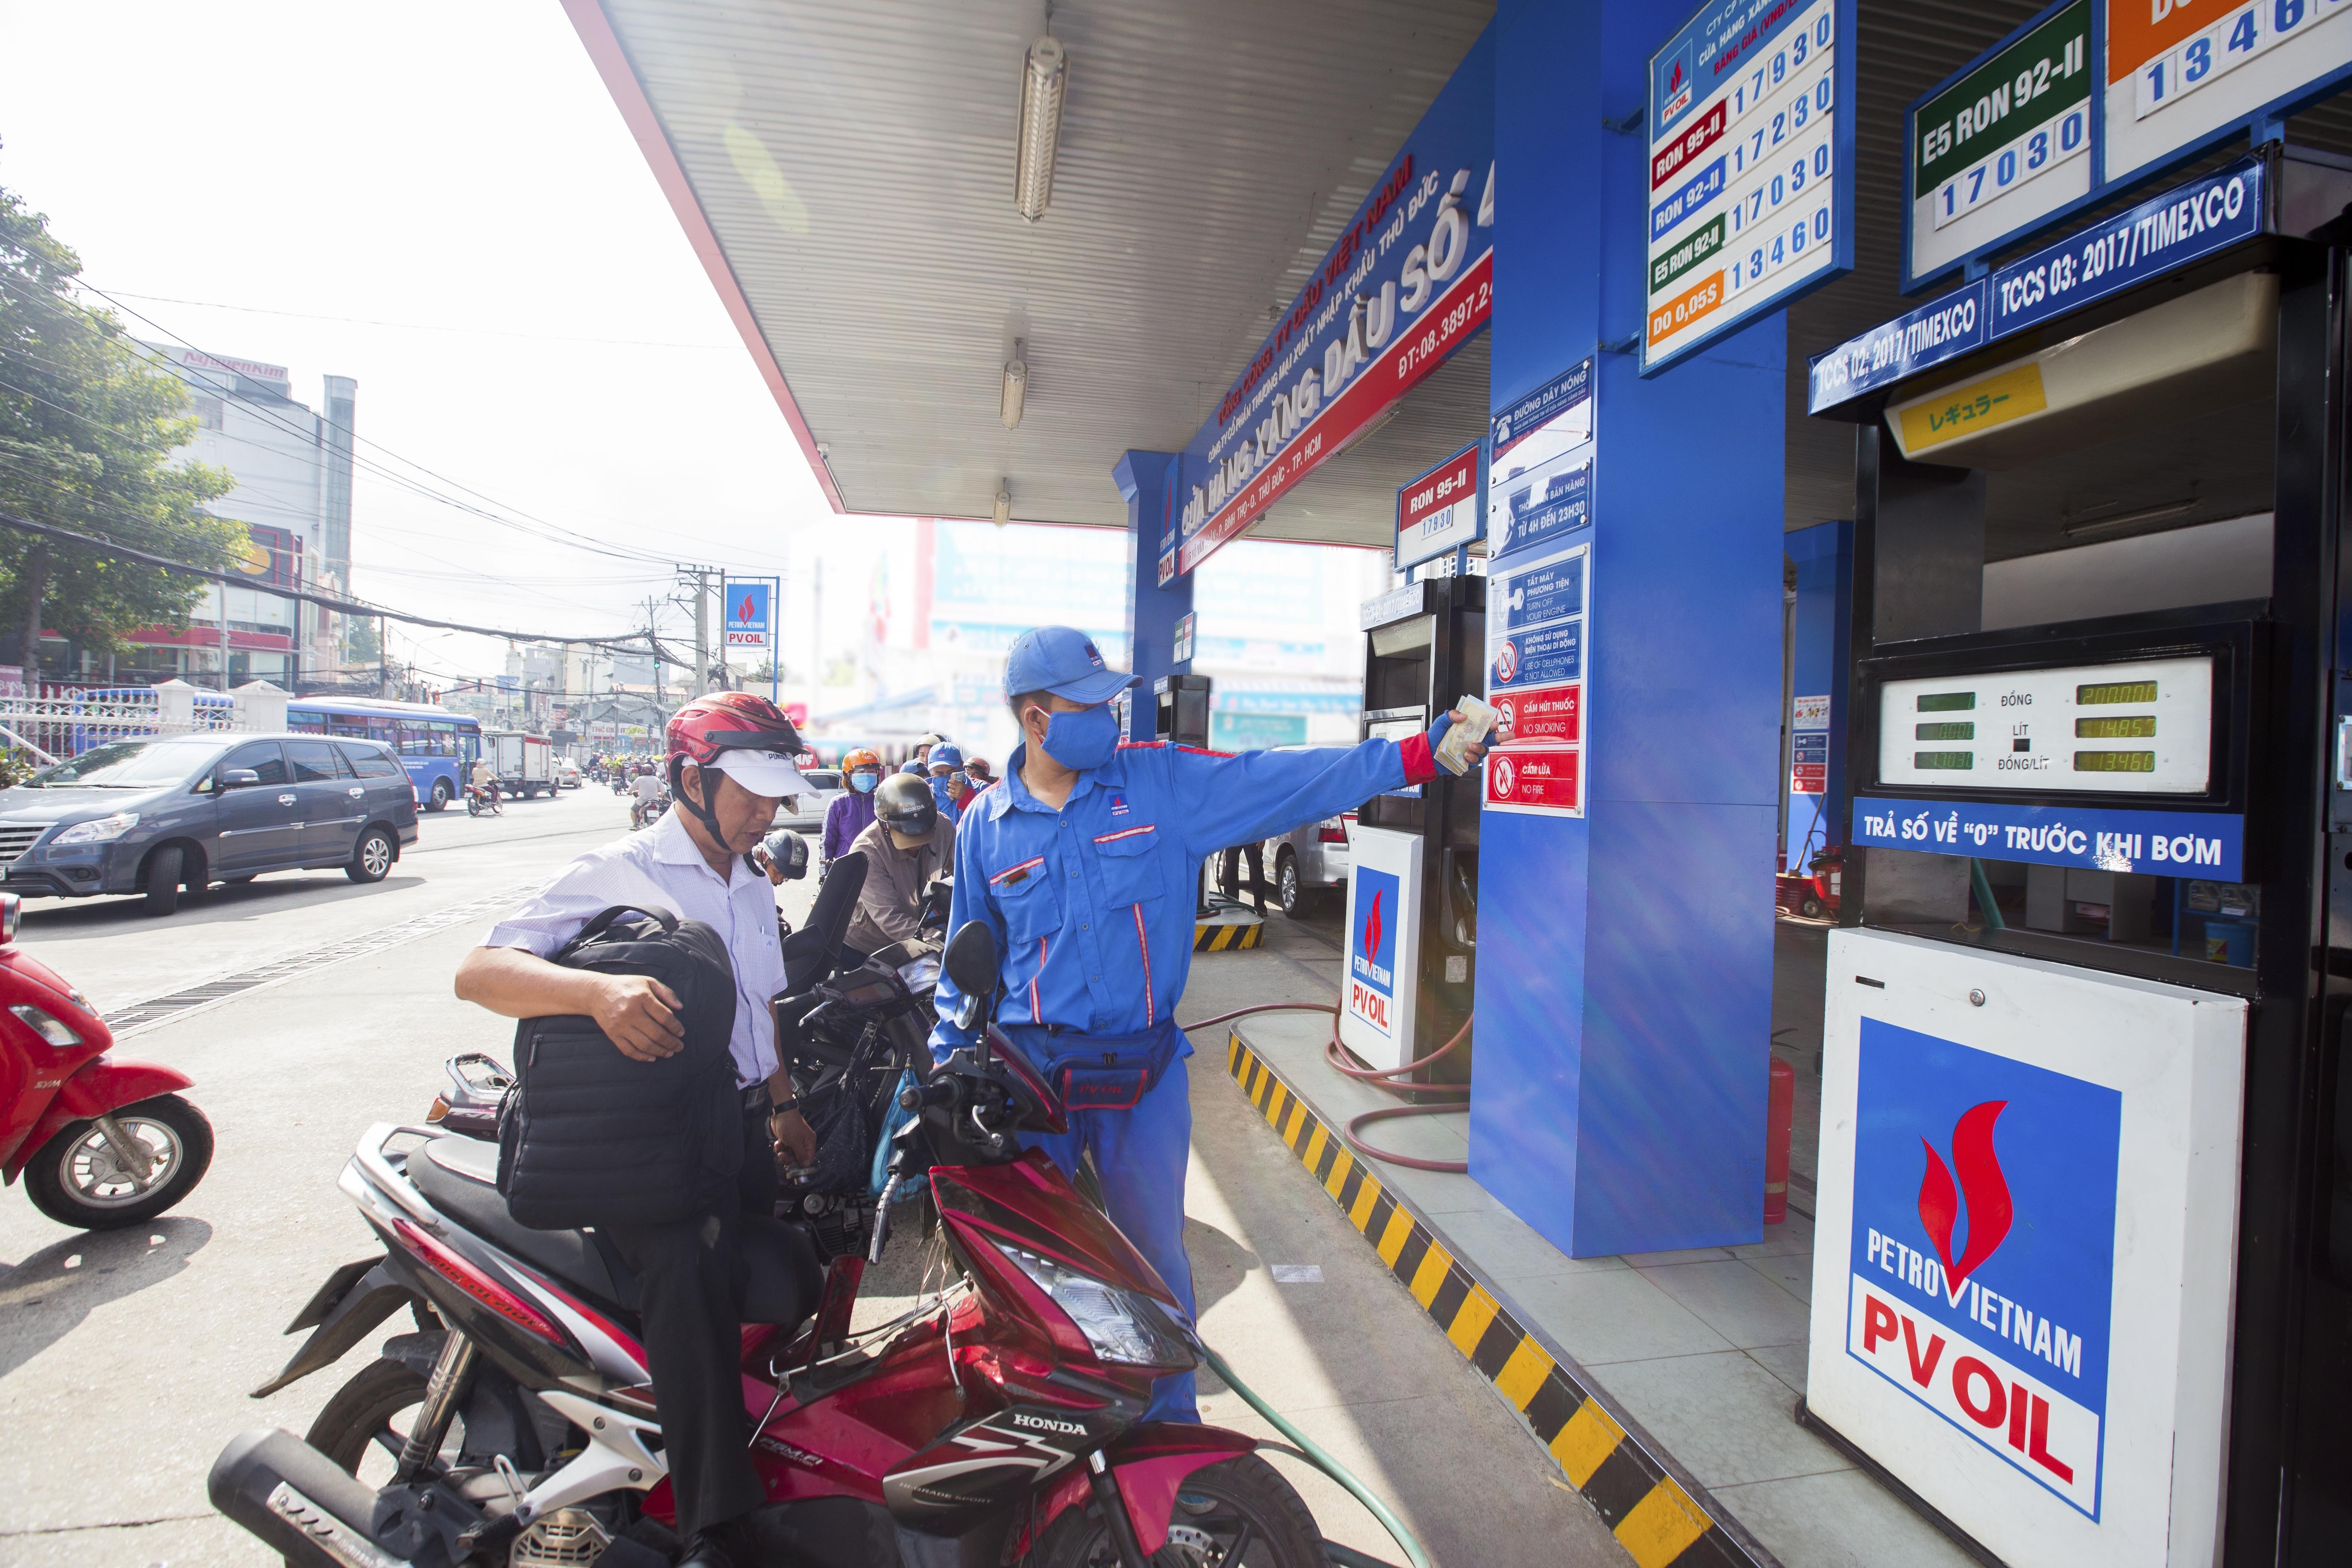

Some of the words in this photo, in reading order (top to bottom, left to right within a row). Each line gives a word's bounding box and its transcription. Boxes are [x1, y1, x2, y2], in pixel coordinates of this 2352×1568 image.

[1706, 12, 1723, 36] CTY
[1720, 14, 1745, 48] HÀNG
[1742, 24, 1758, 50] GIÁ
[1735, 12, 1831, 114] 17930
[2147, 0, 2342, 102] 1346
[1922, 122, 1952, 167] E5
[1956, 82, 2011, 147] RON
[2015, 34, 2085, 109] 92-II
[1734, 77, 1830, 173] 17230
[1656, 141, 1683, 180] RON
[1687, 116, 1721, 155] 95-II
[1942, 112, 2083, 217] 17030
[1655, 202, 1683, 232] RON
[1686, 171, 1720, 208] 92-II
[1733, 143, 1828, 232] 17030
[1654, 262, 1669, 285] E5
[1669, 245, 1693, 271] RON
[1694, 224, 1719, 257] 92-II
[1733, 207, 1829, 290] 13460
[2001, 263, 2046, 317] TCCS
[2049, 257, 2078, 297] 03:
[2082, 176, 2245, 279] 2017/TIMEXCO
[1242, 346, 1273, 395] CÔNG
[1274, 319, 1291, 352] TY
[1292, 279, 1323, 333] DẦU
[1324, 220, 1364, 286] VIỆT
[1365, 153, 1412, 234] NAM
[1208, 440, 1222, 463] CÔNG
[1221, 432, 1228, 448] TY
[1279, 355, 1292, 381] MẠI
[1293, 322, 1316, 364] XUẤT
[1317, 291, 1343, 336] NHẬP
[1345, 247, 1375, 300] KHẨU
[1379, 207, 1405, 256] THỦ
[1408, 169, 1439, 222] ĐỨC
[1653, 309, 1672, 336] DO
[1675, 283, 1718, 322] 0,05S
[1399, 282, 1492, 380] ĐT:08.3897.2
[1817, 353, 1850, 392] TCCS
[1850, 348, 1871, 382] 02:
[1871, 298, 1977, 369] 2017/TIMEXCO
[1182, 485, 1207, 536] CỬA
[1208, 440, 1254, 512] HÀNG
[1254, 368, 1320, 466] XĂNG
[1324, 280, 1396, 396] DẦU
[1400, 168, 1471, 312] SỐ
[1514, 397, 1542, 421] ĐƯỜNG
[1543, 385, 1560, 404] DÂY
[1561, 370, 1587, 394] NÓNG
[1929, 392, 2010, 432] レギュラー
[1224, 510, 1235, 532] BÌNH
[1259, 475, 1271, 500] THỦ
[1272, 466, 1285, 490] ĐỨC
[1305, 433, 1322, 461] HCM
[1410, 487, 1434, 514] RON
[1437, 468, 1467, 499] 95-II
[1550, 486, 1564, 499] BÁN
[1565, 477, 1586, 493] HÀNG
[1423, 509, 1451, 536] 17930
[1518, 521, 1527, 538] TỪ
[1528, 521, 1539, 533] 4H
[1540, 508, 1556, 530] ĐẾN
[1558, 500, 1585, 523] 23H30
[1527, 575, 1538, 587] TẮT
[1540, 572, 1555, 583] MÁY
[1527, 582, 1554, 597] PHƯƠNG
[1556, 577, 1570, 589] TIỆN
[1527, 600, 1541, 610] TURN
[1542, 597, 1554, 607] OFF
[1527, 611, 1542, 622] YOUR
[1543, 605, 1566, 617] ENGINE
[1525, 644, 1536, 655] ĐIỆN
[1537, 641, 1552, 652] THOẠI
[1559, 638, 1576, 649] ĐỘNG
[1526, 634, 1544, 645] KHÔNG
[1545, 630, 1552, 640] SỬ
[1553, 629, 1568, 641] DỤNG
[1525, 662, 1534, 671] USE
[1534, 661, 1542, 669] OF
[1542, 655, 1575, 668] CELLPHONES
[1525, 673, 1529, 681] IS
[1529, 671, 1540, 680] NOT
[1540, 668, 1565, 679] ALLOWED
[1524, 700, 1537, 714] CẤM
[1539, 700, 1551, 712] HÚT
[1552, 697, 1575, 710] THUỐC
[2001, 690, 2032, 706] ĐỒNG
[2083, 684, 2157, 704] 200.000
[1523, 724, 1533, 734] NO
[1534, 723, 1566, 733] SMOKING
[2013, 721, 2028, 736] LÍT
[2100, 719, 2156, 737] 14.857
[1522, 762, 1537, 774] CẤM
[1538, 763, 1550, 775] LỬA
[1998, 754, 2050, 770] ĐỒNG/LÍT
[2099, 753, 2154, 771] 13.460
[1522, 785, 1531, 793] NO
[1533, 785, 1544, 794] FIRE
[903, 805, 925, 813] HONDA
[1865, 811, 1895, 838] TRẢ
[1902, 812, 1929, 842] SỐ
[1934, 811, 1959, 844] VỀ
[2006, 825, 2087, 854] TRƯỚC
[2096, 832, 2141, 859] KHI
[2152, 836, 2222, 866] BƠM
[1354, 955, 1390, 988] PETROVIETNAM
[34, 1080, 61, 1089] SYM
[1867, 1227, 2082, 1379] PETROVIETNAM
[1014, 1414, 1088, 1436] HONDA
